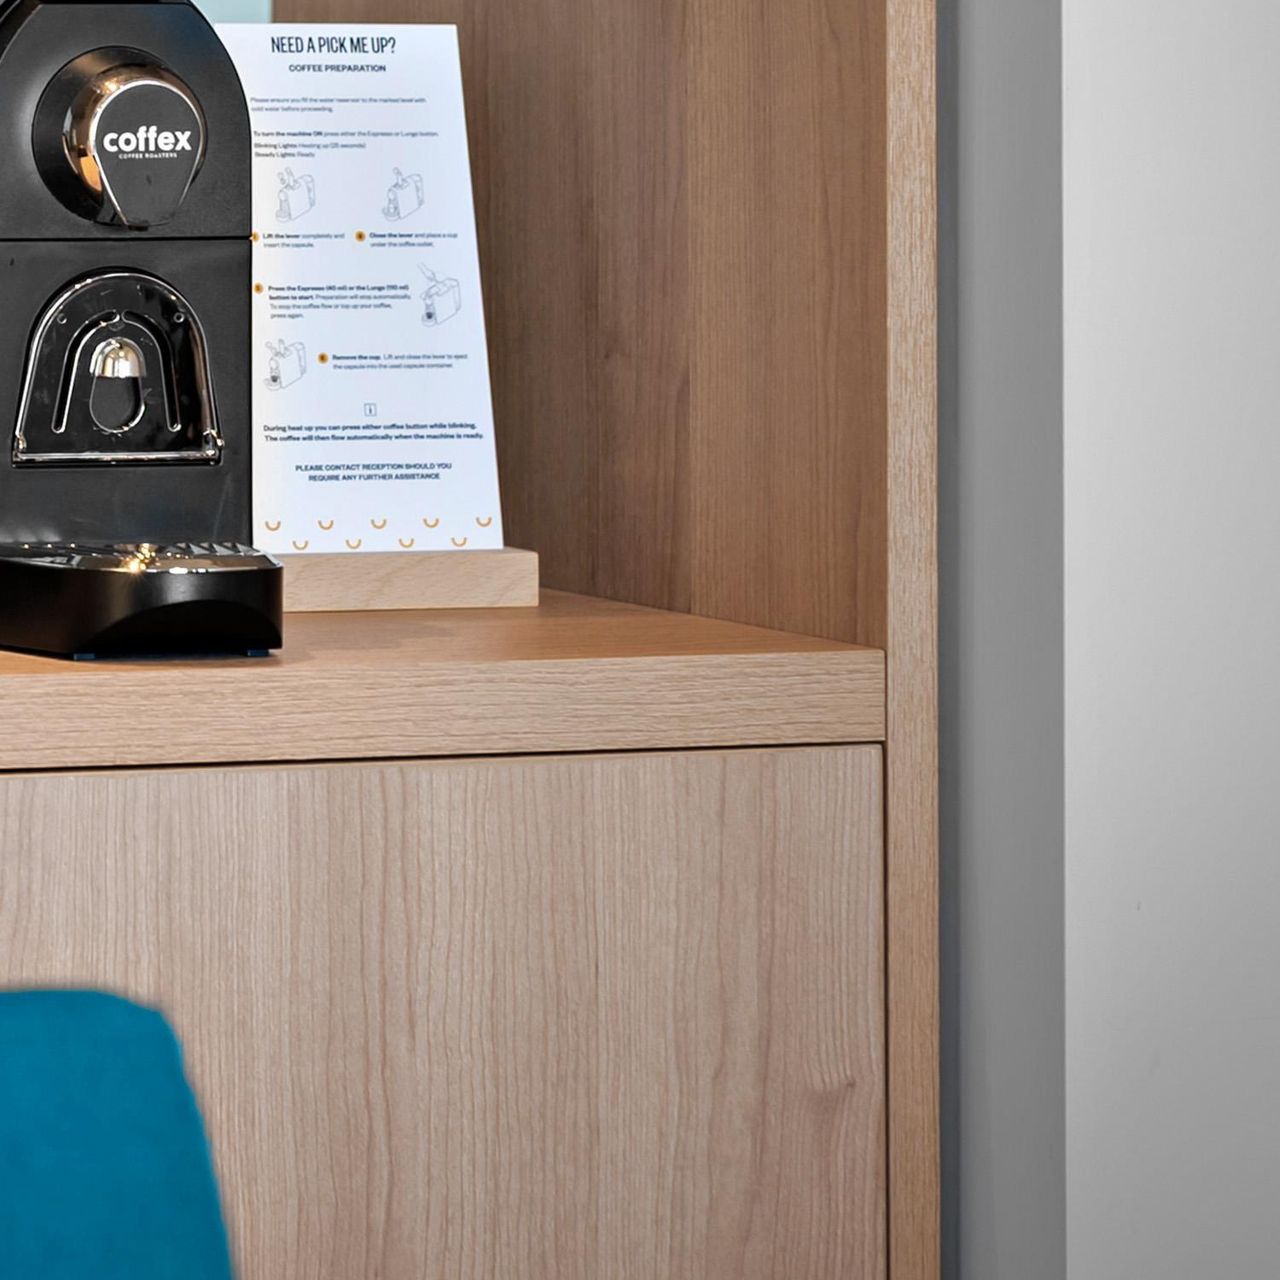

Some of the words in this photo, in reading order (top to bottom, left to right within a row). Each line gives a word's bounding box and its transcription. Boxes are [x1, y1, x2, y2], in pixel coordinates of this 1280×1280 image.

[271, 37, 304, 53] NEED
[307, 37, 316, 53] A
[318, 37, 347, 53] PICK
[349, 37, 369, 53] ME
[371, 37, 396, 53] UP?
[289, 64, 323, 72] COFFEE
[324, 64, 386, 72] PREPARATION
[103, 125, 192, 152] coffex
